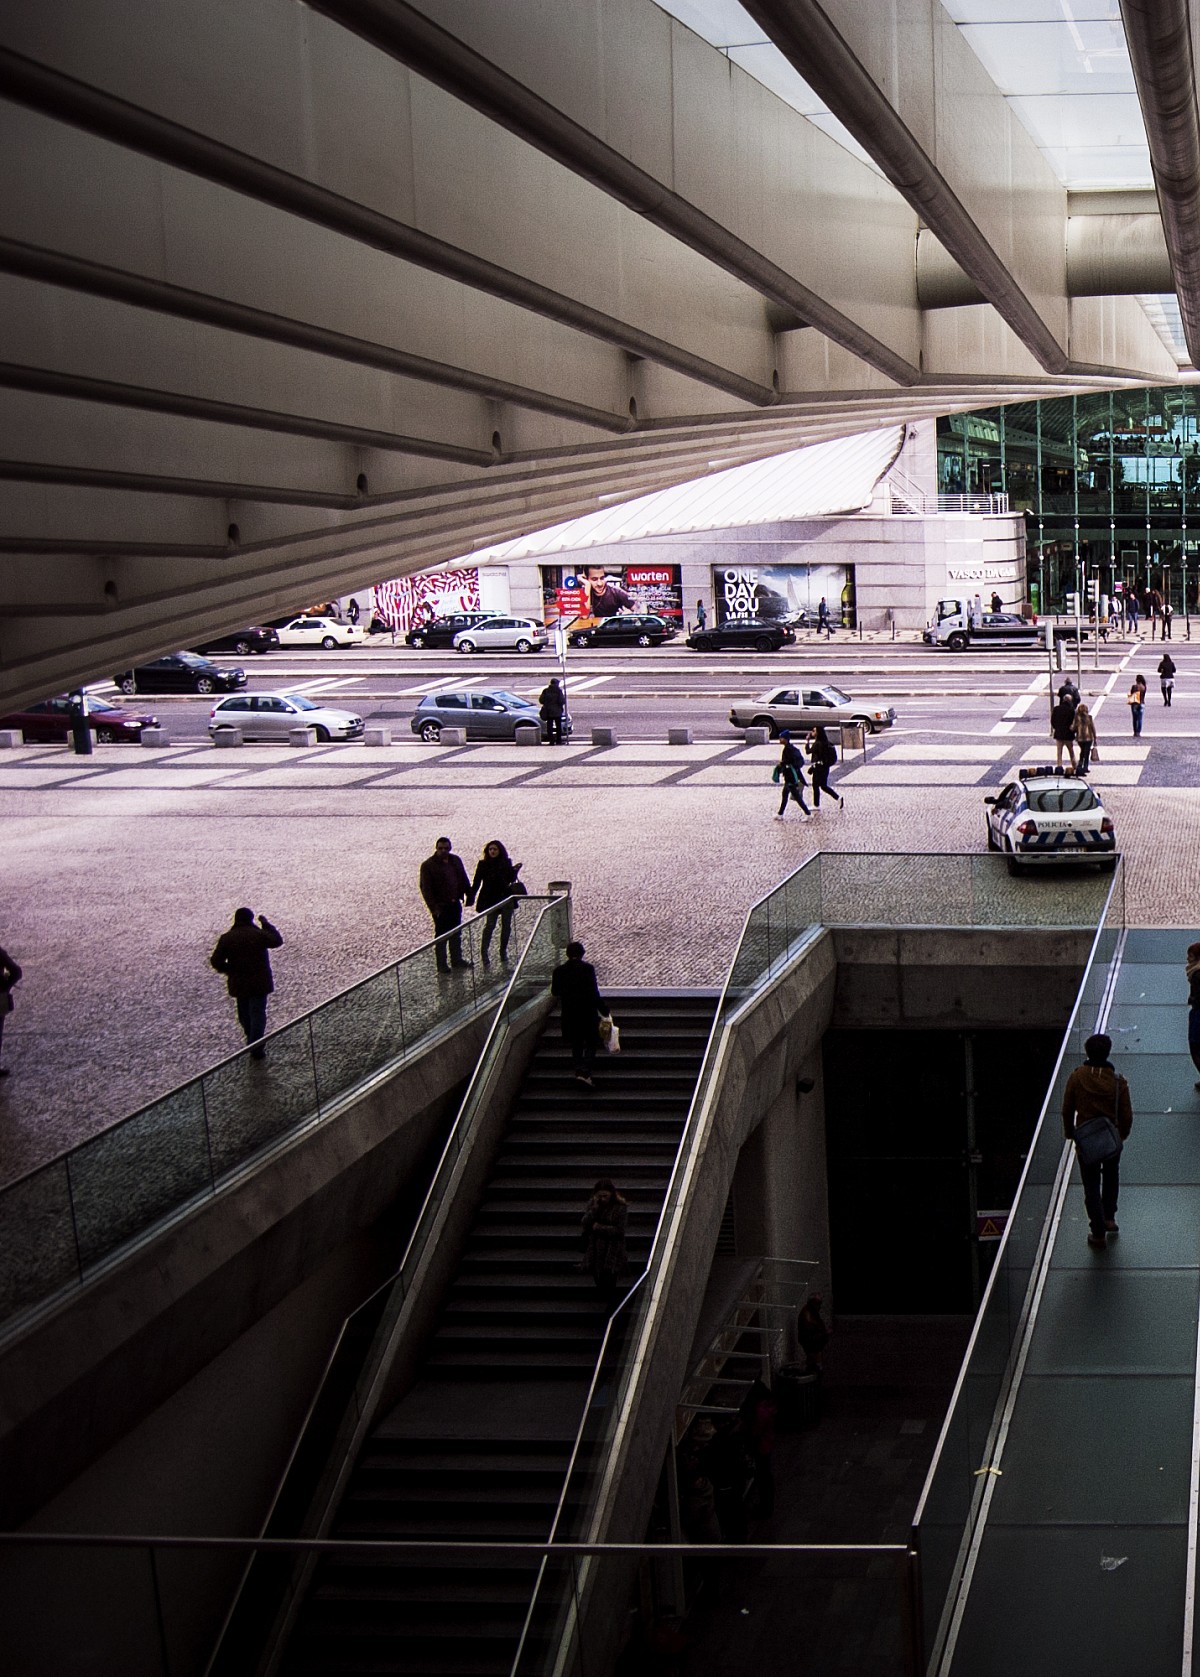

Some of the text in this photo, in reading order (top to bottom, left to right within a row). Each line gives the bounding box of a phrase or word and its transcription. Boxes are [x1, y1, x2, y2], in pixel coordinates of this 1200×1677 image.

[631, 572, 669, 581] worten
[724, 569, 758, 583] ONE
[949, 569, 983, 579] VASCO
[724, 583, 757, 598] DAY
[726, 598, 759, 612] YOU
